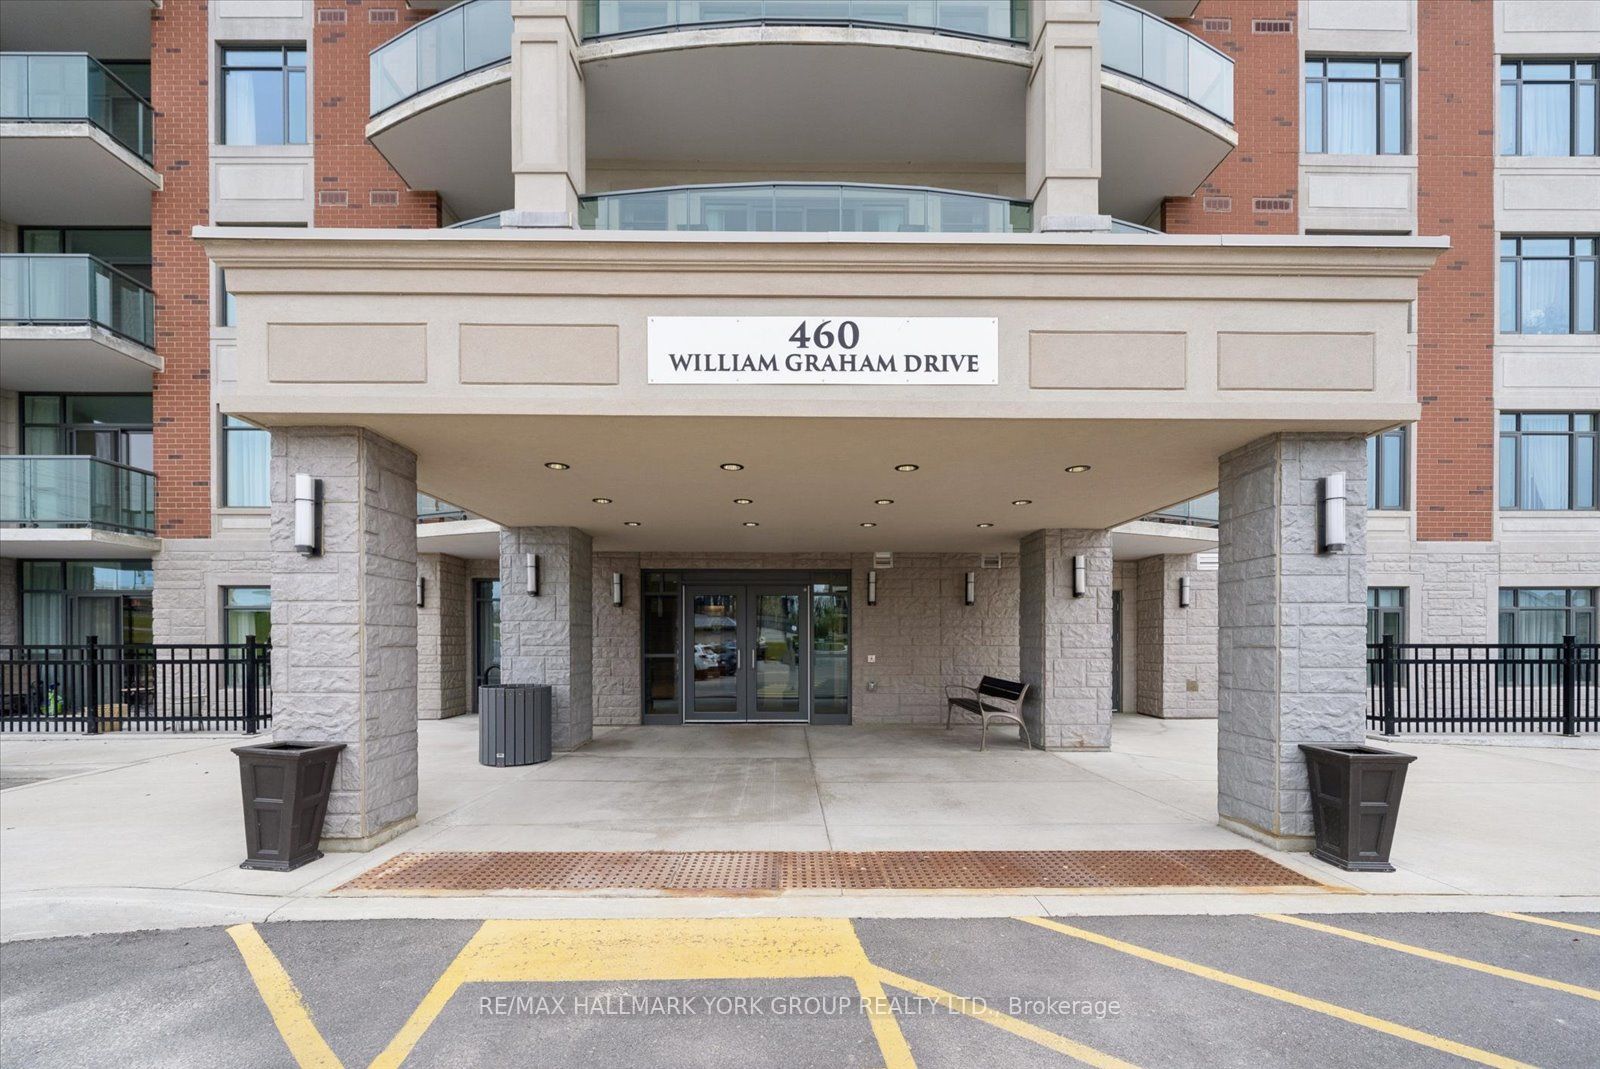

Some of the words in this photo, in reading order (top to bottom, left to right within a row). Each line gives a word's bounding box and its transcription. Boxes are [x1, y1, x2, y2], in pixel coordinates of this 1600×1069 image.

[788, 320, 860, 350] 460
[669, 353, 779, 373] WILLIAM
[785, 353, 898, 373] GRAHAM
[904, 354, 979, 373] DRIVE
